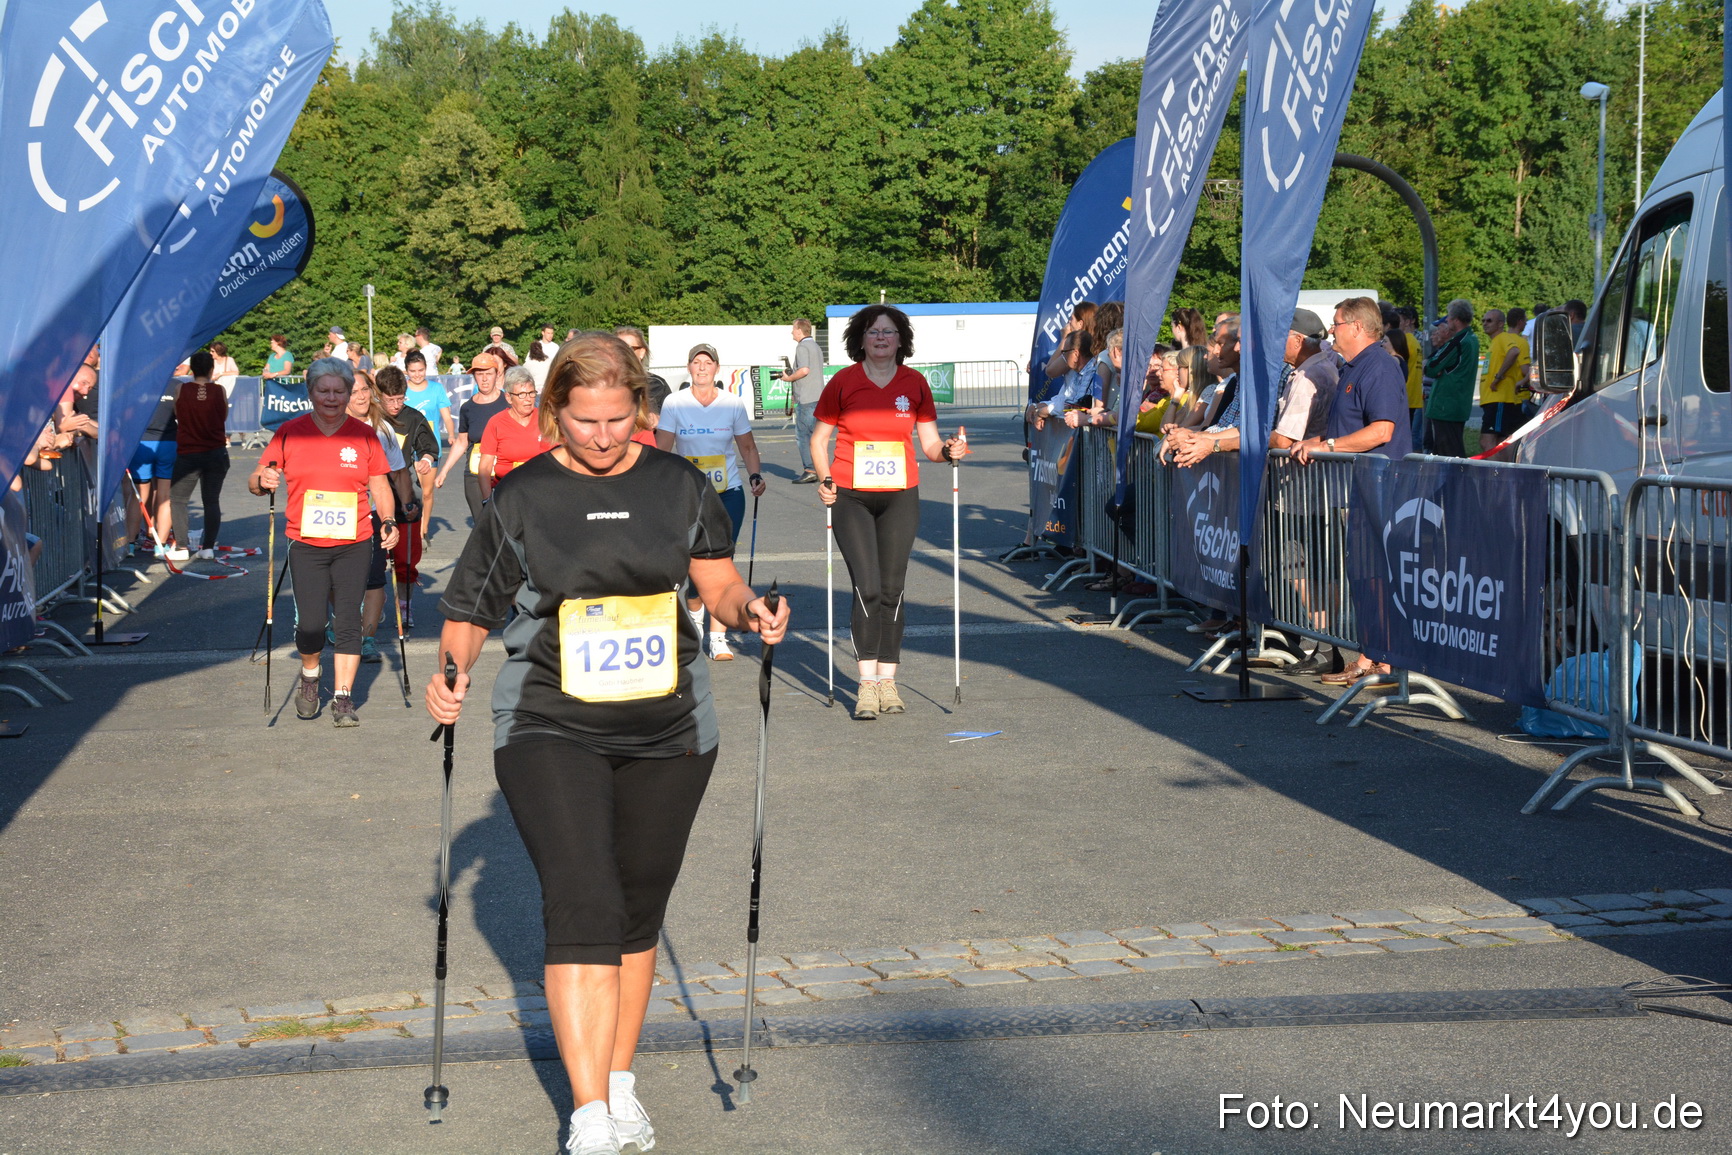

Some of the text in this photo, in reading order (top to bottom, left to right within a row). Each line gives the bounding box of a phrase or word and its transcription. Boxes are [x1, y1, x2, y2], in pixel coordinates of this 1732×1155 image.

[73, 0, 206, 167] Fisc
[1180, 10, 1240, 195] AUTOMOBILE
[208, 45, 297, 216] AUTOMOBILE
[219, 271, 249, 298] Druck
[268, 232, 304, 265] Medien
[1103, 255, 1129, 286] Druck
[864, 460, 896, 475] 263
[313, 509, 346, 526] 265
[1399, 550, 1505, 621] Fischer
[575, 634, 666, 673] 1259
[1413, 618, 1499, 658] AUTOMOBILE
